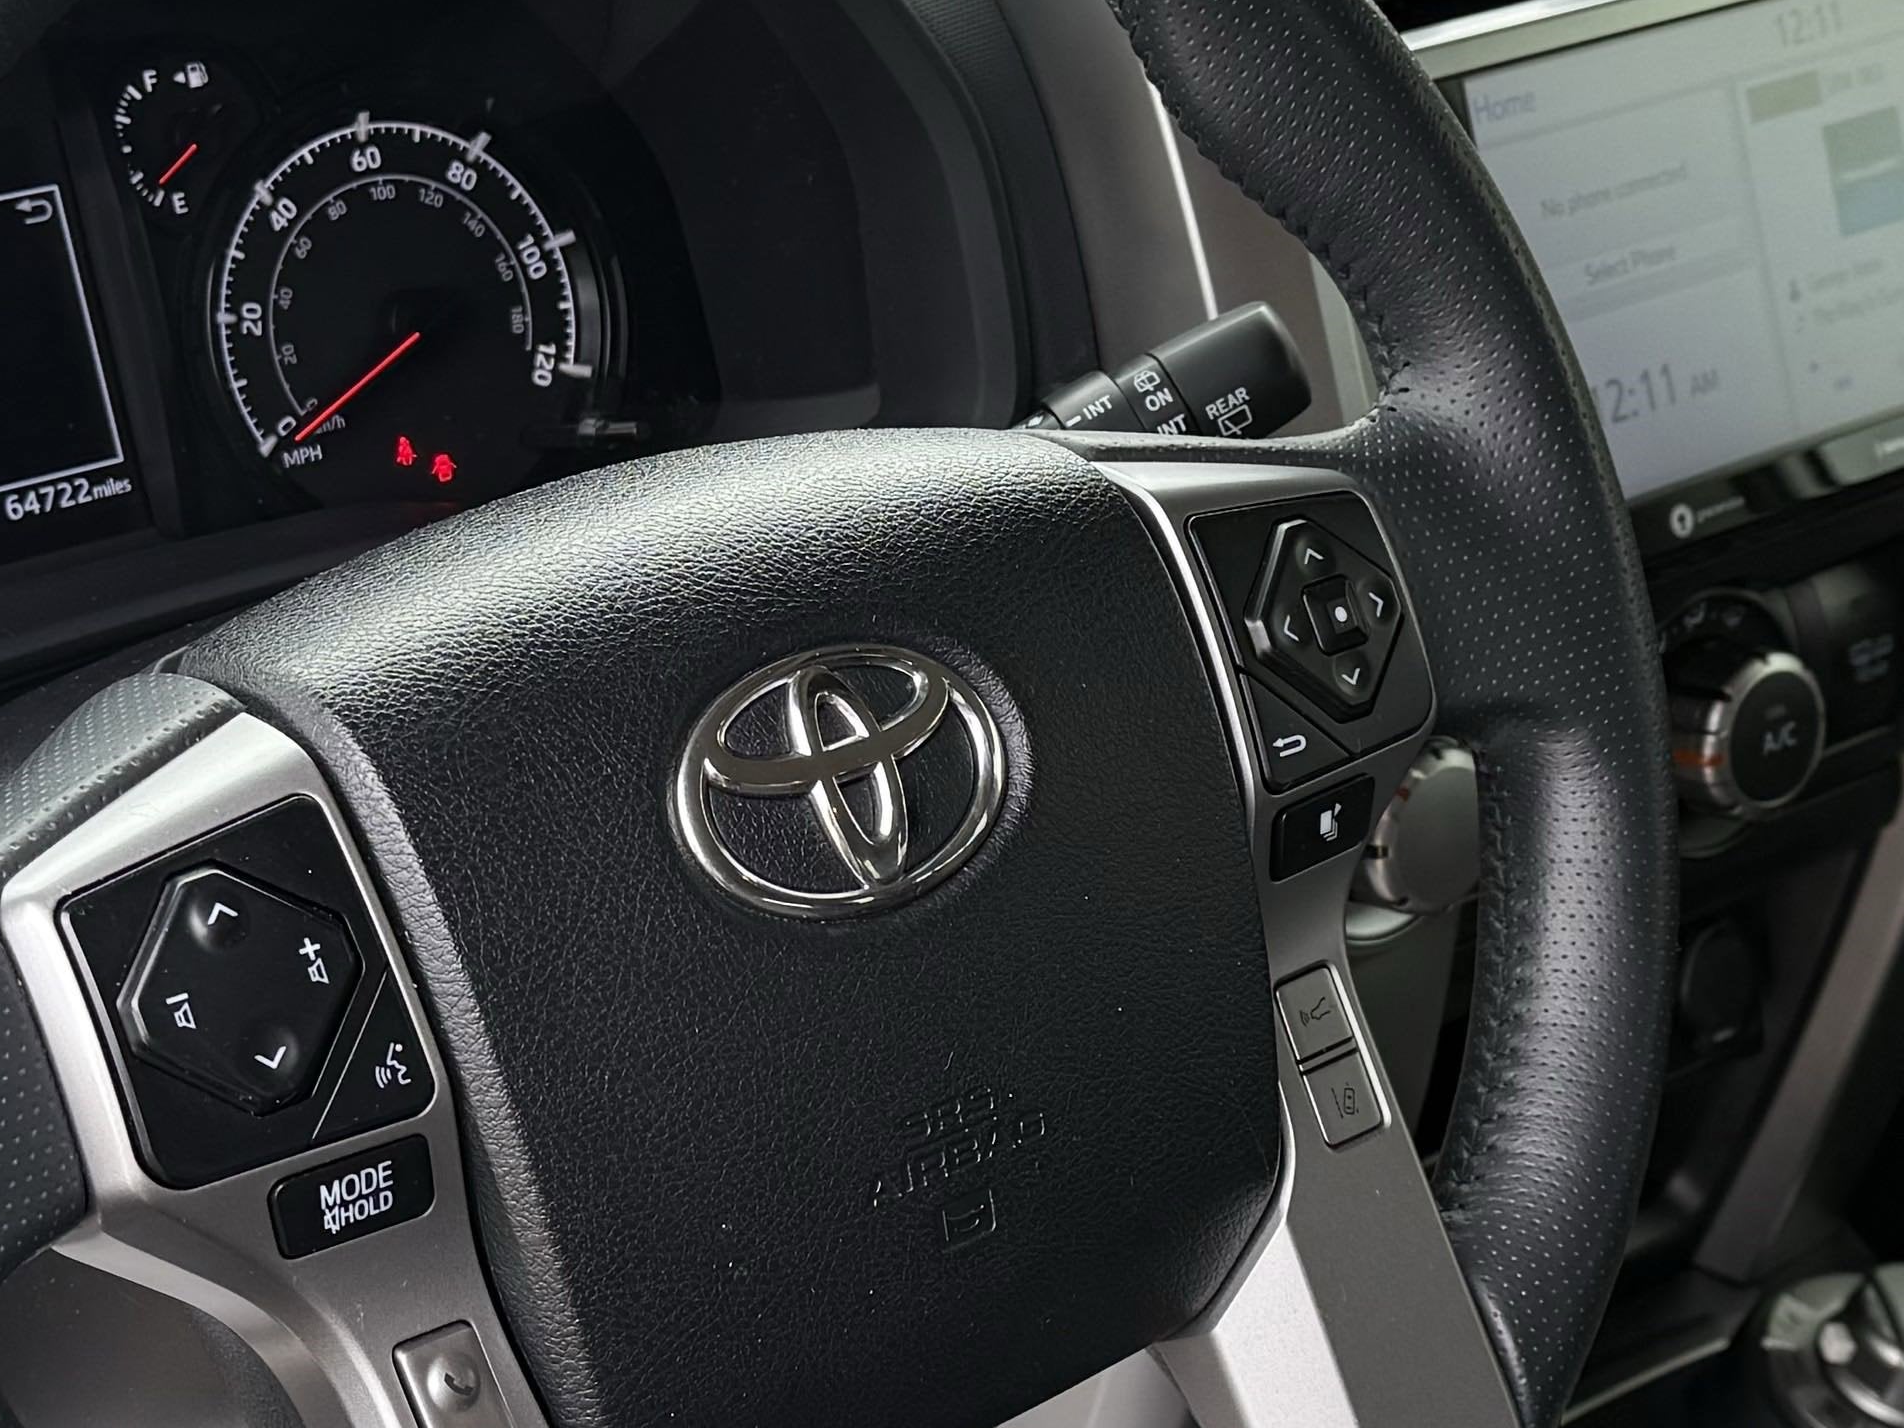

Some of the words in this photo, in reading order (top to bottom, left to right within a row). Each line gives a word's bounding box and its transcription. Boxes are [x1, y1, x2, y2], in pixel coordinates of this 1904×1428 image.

[142, 69, 158, 92] F
[1473, 90, 1536, 122] Home
[351, 145, 382, 172] 60
[447, 160, 478, 191] 80
[171, 191, 189, 215] E
[370, 184, 397, 202] 100
[418, 188, 445, 209] 120
[269, 196, 298, 232] 40
[327, 200, 348, 221] 80
[462, 211, 486, 238] 140
[516, 233, 548, 280] 100
[240, 301, 263, 337] 20
[530, 342, 558, 388] 120
[1082, 394, 1113, 422] INT
[1145, 388, 1174, 412] ON
[1205, 386, 1251, 420] REAR
[283, 444, 323, 469] MPH
[3, 478, 94, 521] 64722
[92, 477, 132, 500] miles
[1762, 721, 1797, 756] A/C
[320, 1160, 394, 1210] MODE
[340, 1190, 393, 1227] HOLD
